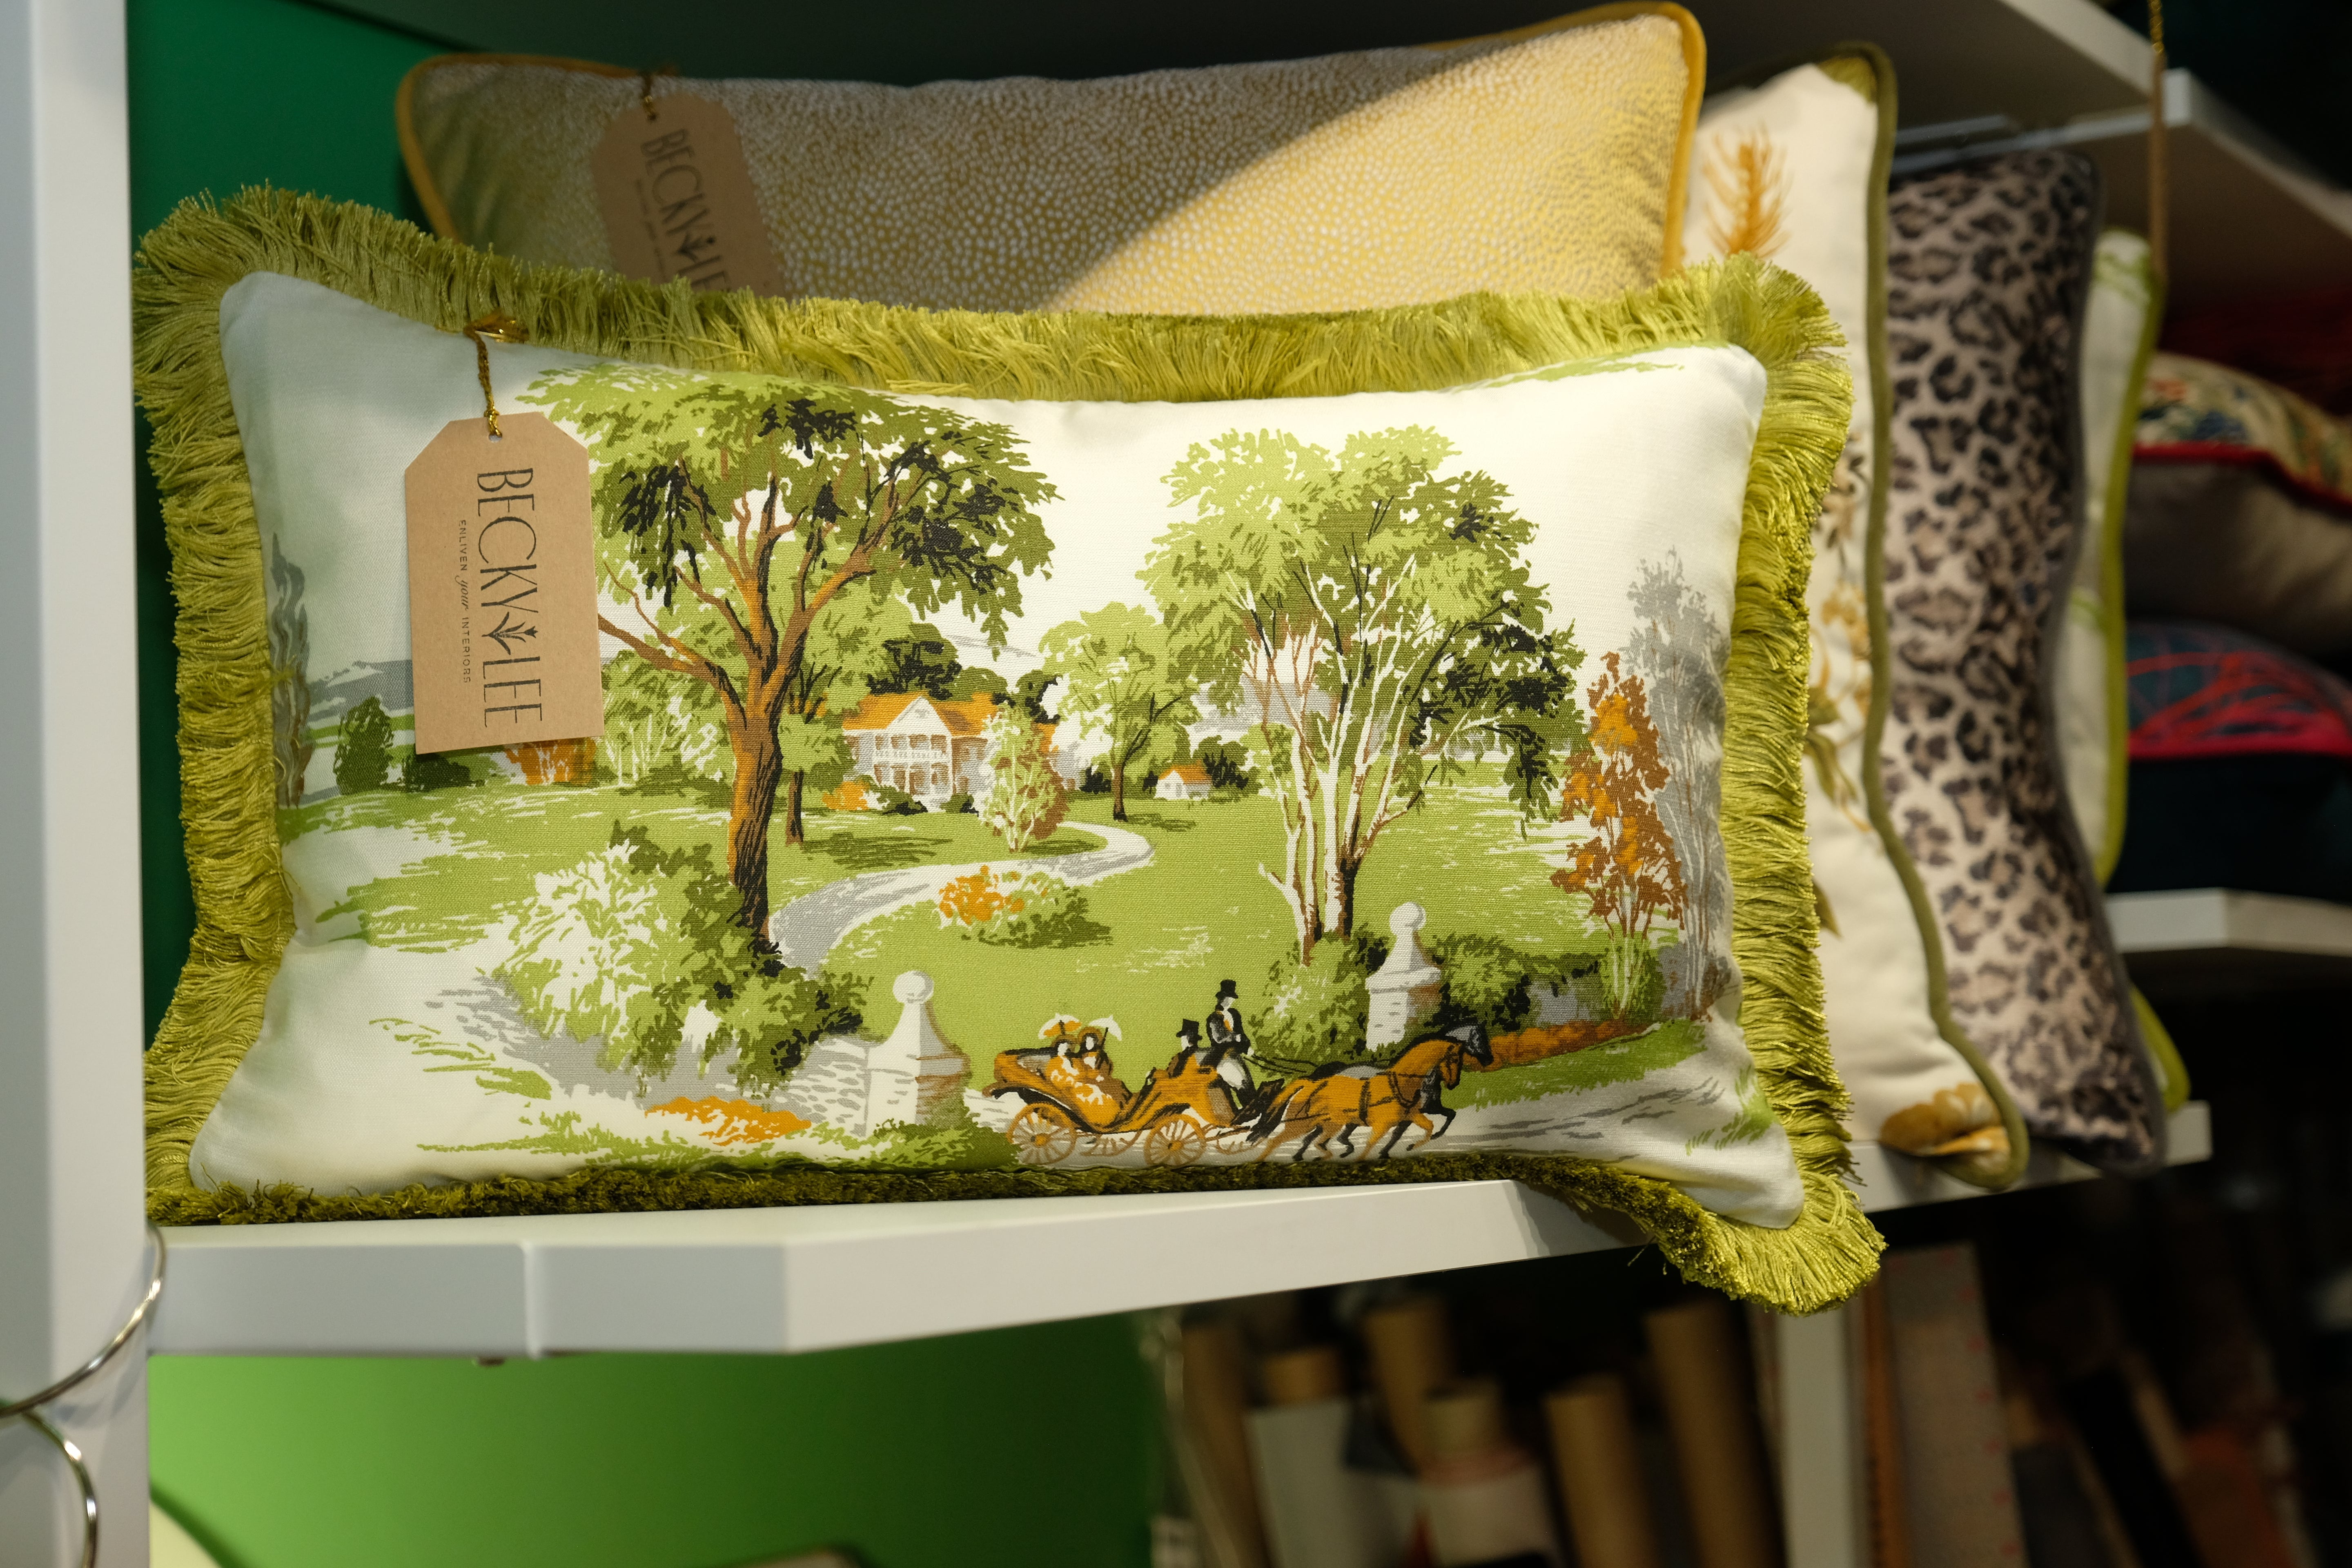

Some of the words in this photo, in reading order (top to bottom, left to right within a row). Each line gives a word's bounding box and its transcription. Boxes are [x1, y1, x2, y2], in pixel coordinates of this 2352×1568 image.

[640, 127, 715, 235] BECKY
[676, 254, 733, 292] LE
[458, 519, 468, 571] ENLIVEN
[477, 468, 539, 612] BECKY
[454, 575, 470, 611] your
[462, 617, 471, 683] INTERIORS
[483, 656, 542, 728] LEE
